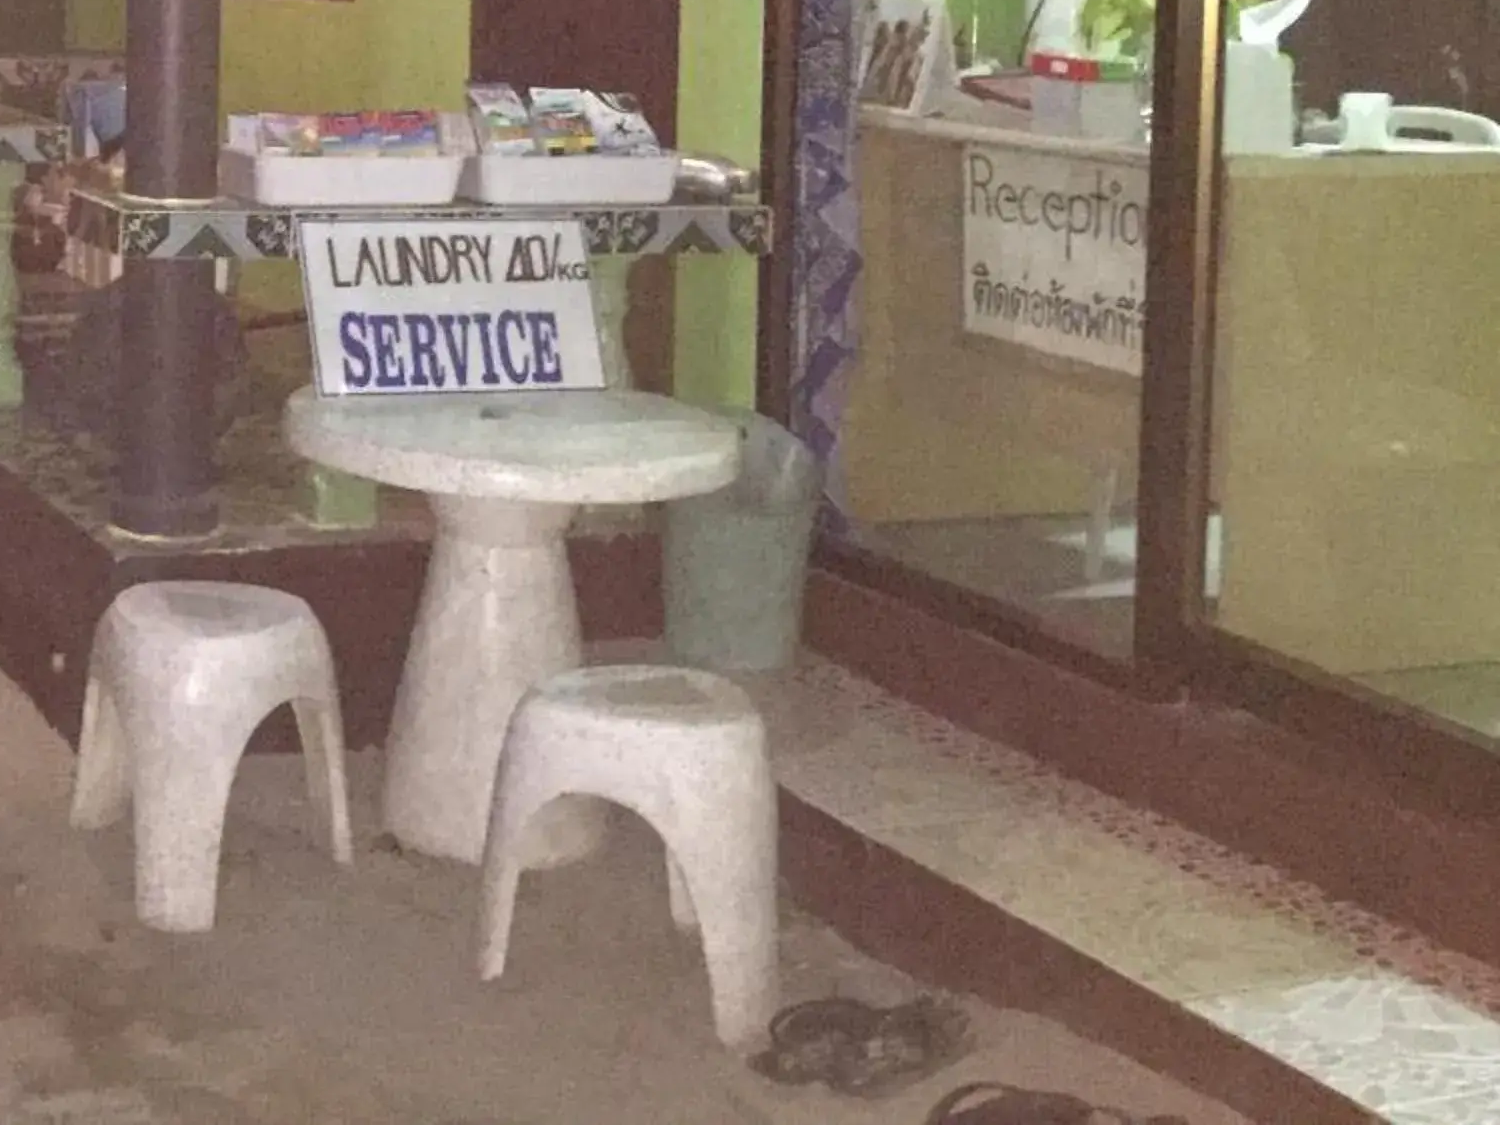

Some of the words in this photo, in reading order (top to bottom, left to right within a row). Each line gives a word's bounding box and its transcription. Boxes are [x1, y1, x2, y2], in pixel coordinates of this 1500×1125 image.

[970, 154, 1141, 261] Receptio
[326, 236, 491, 287] LAUNDRY
[340, 310, 562, 387] SERVICE
